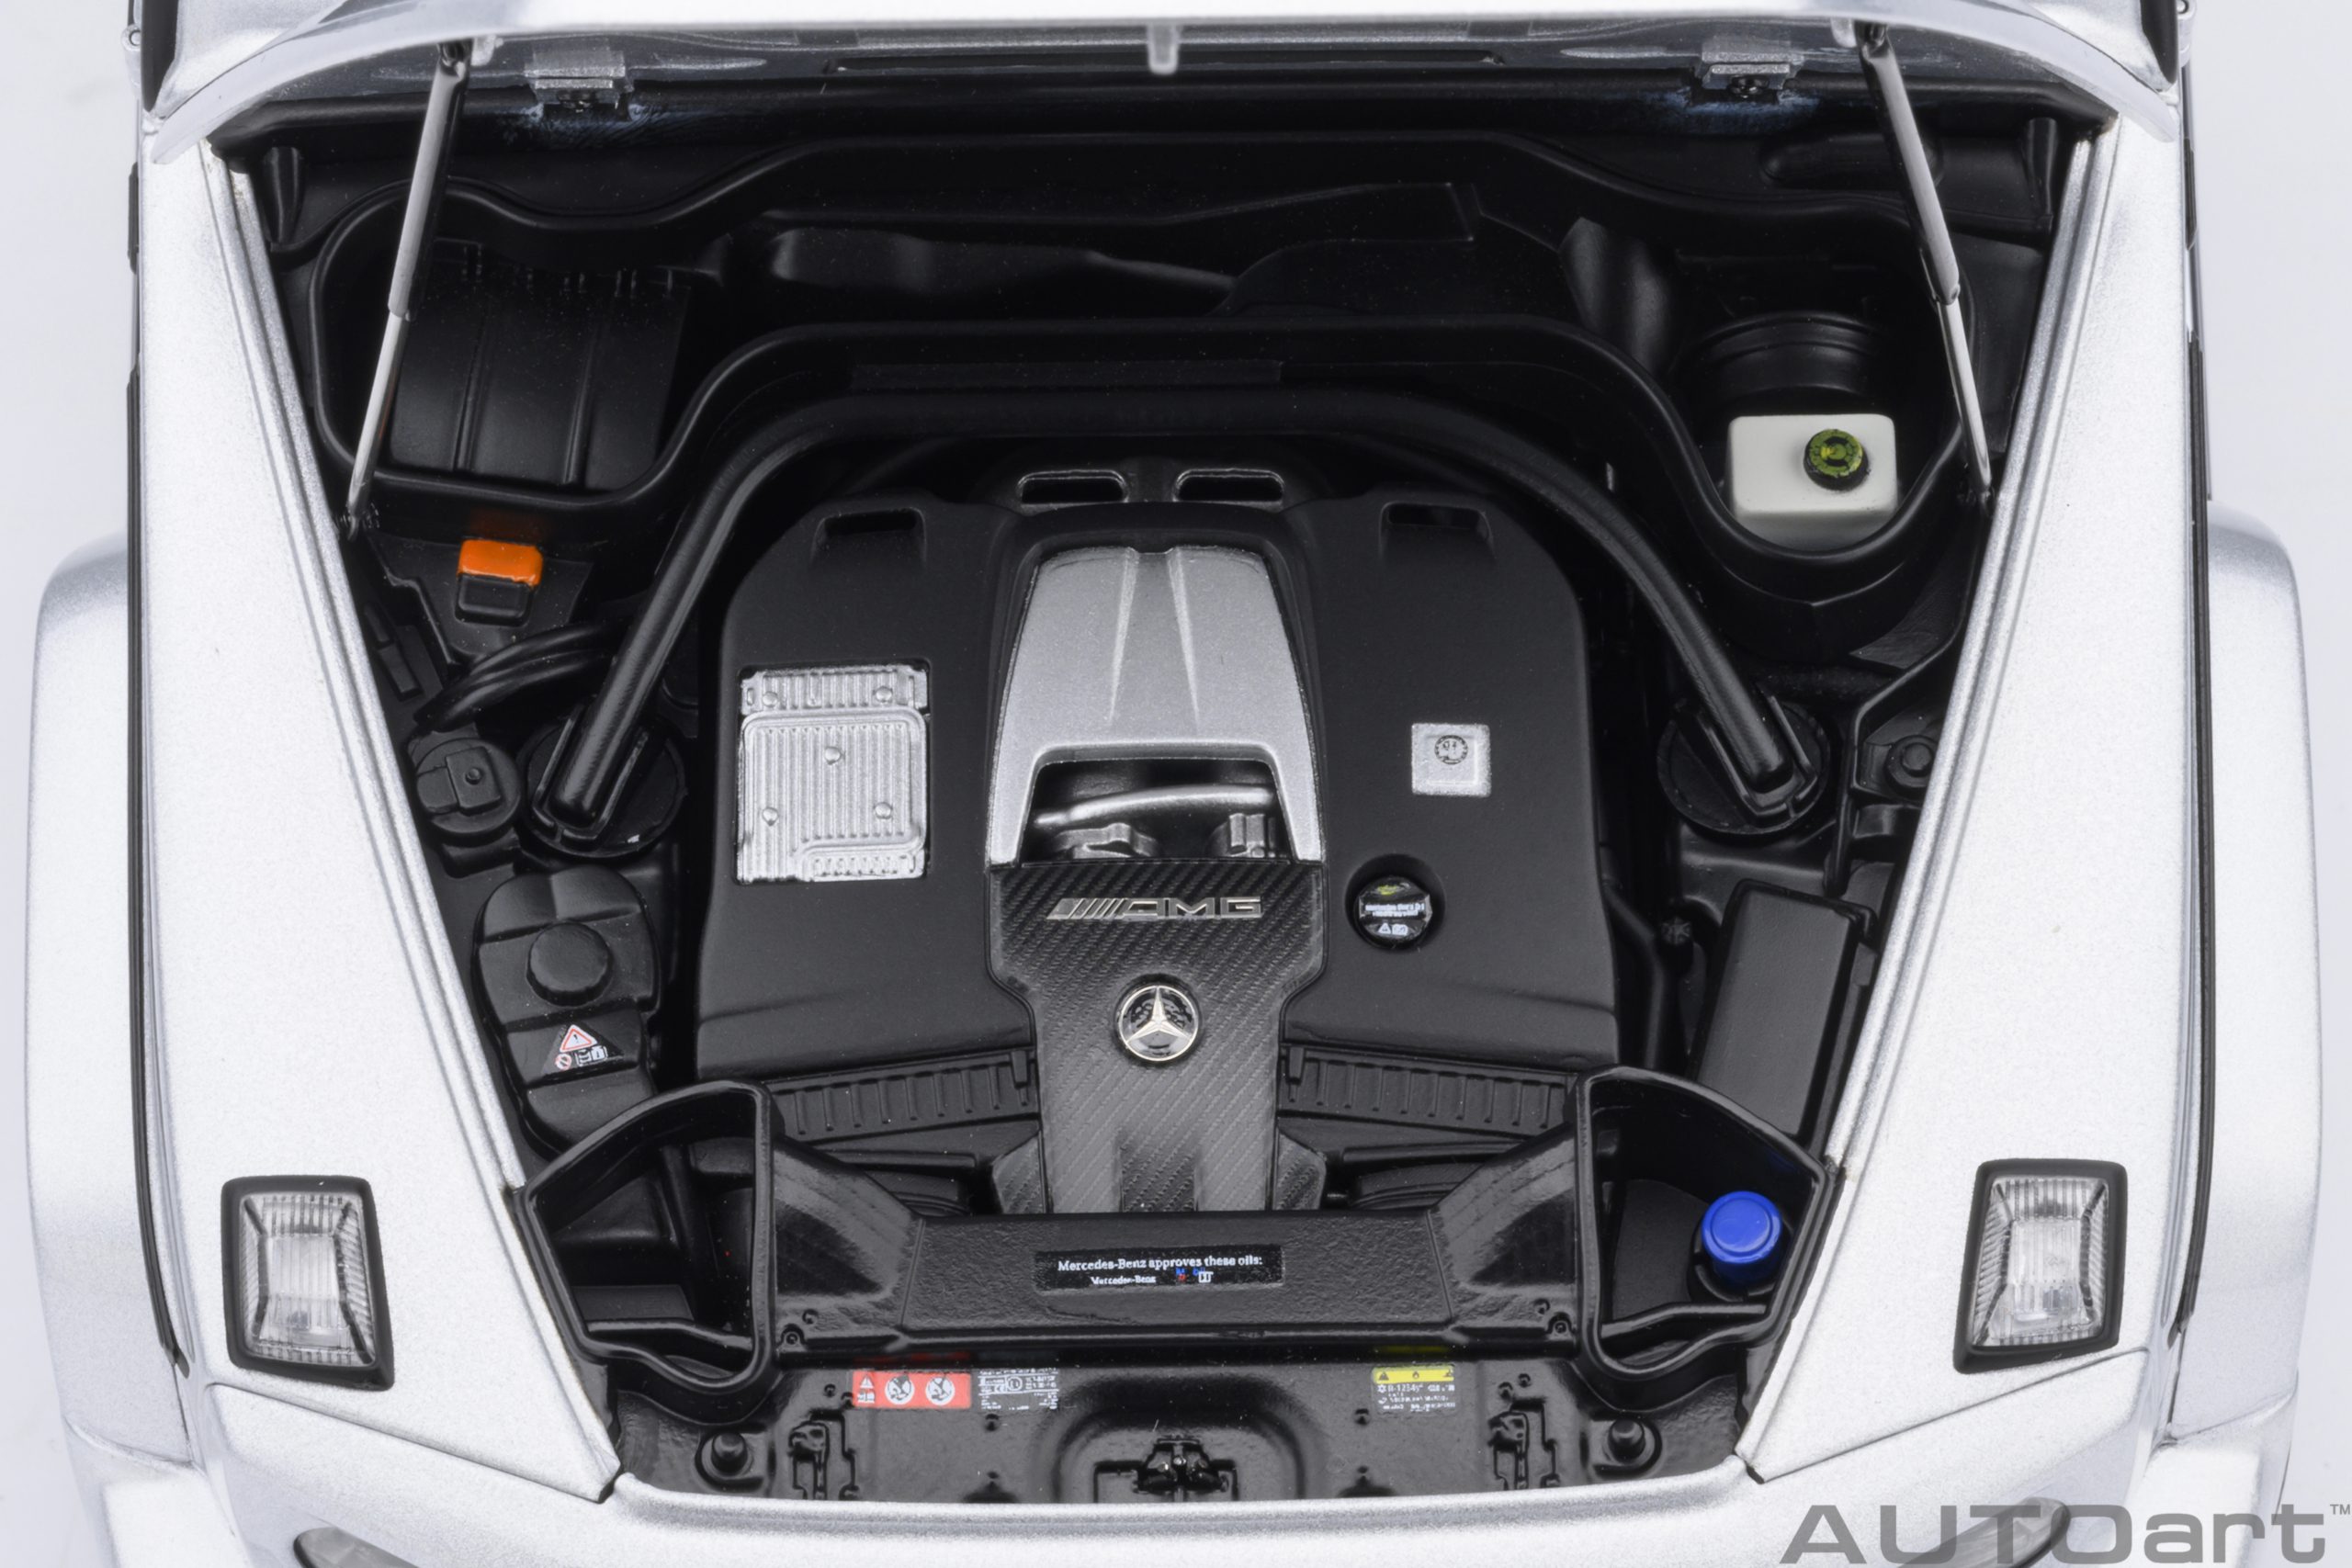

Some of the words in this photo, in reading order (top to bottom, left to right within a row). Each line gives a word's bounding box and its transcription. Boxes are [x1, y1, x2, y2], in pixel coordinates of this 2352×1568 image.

[1057, 1258, 1147, 1272] Mercedes-Benz
[1148, 1258, 1203, 1271] approves
[1204, 1256, 1236, 1268] these
[1238, 1255, 1263, 1266] oils:
